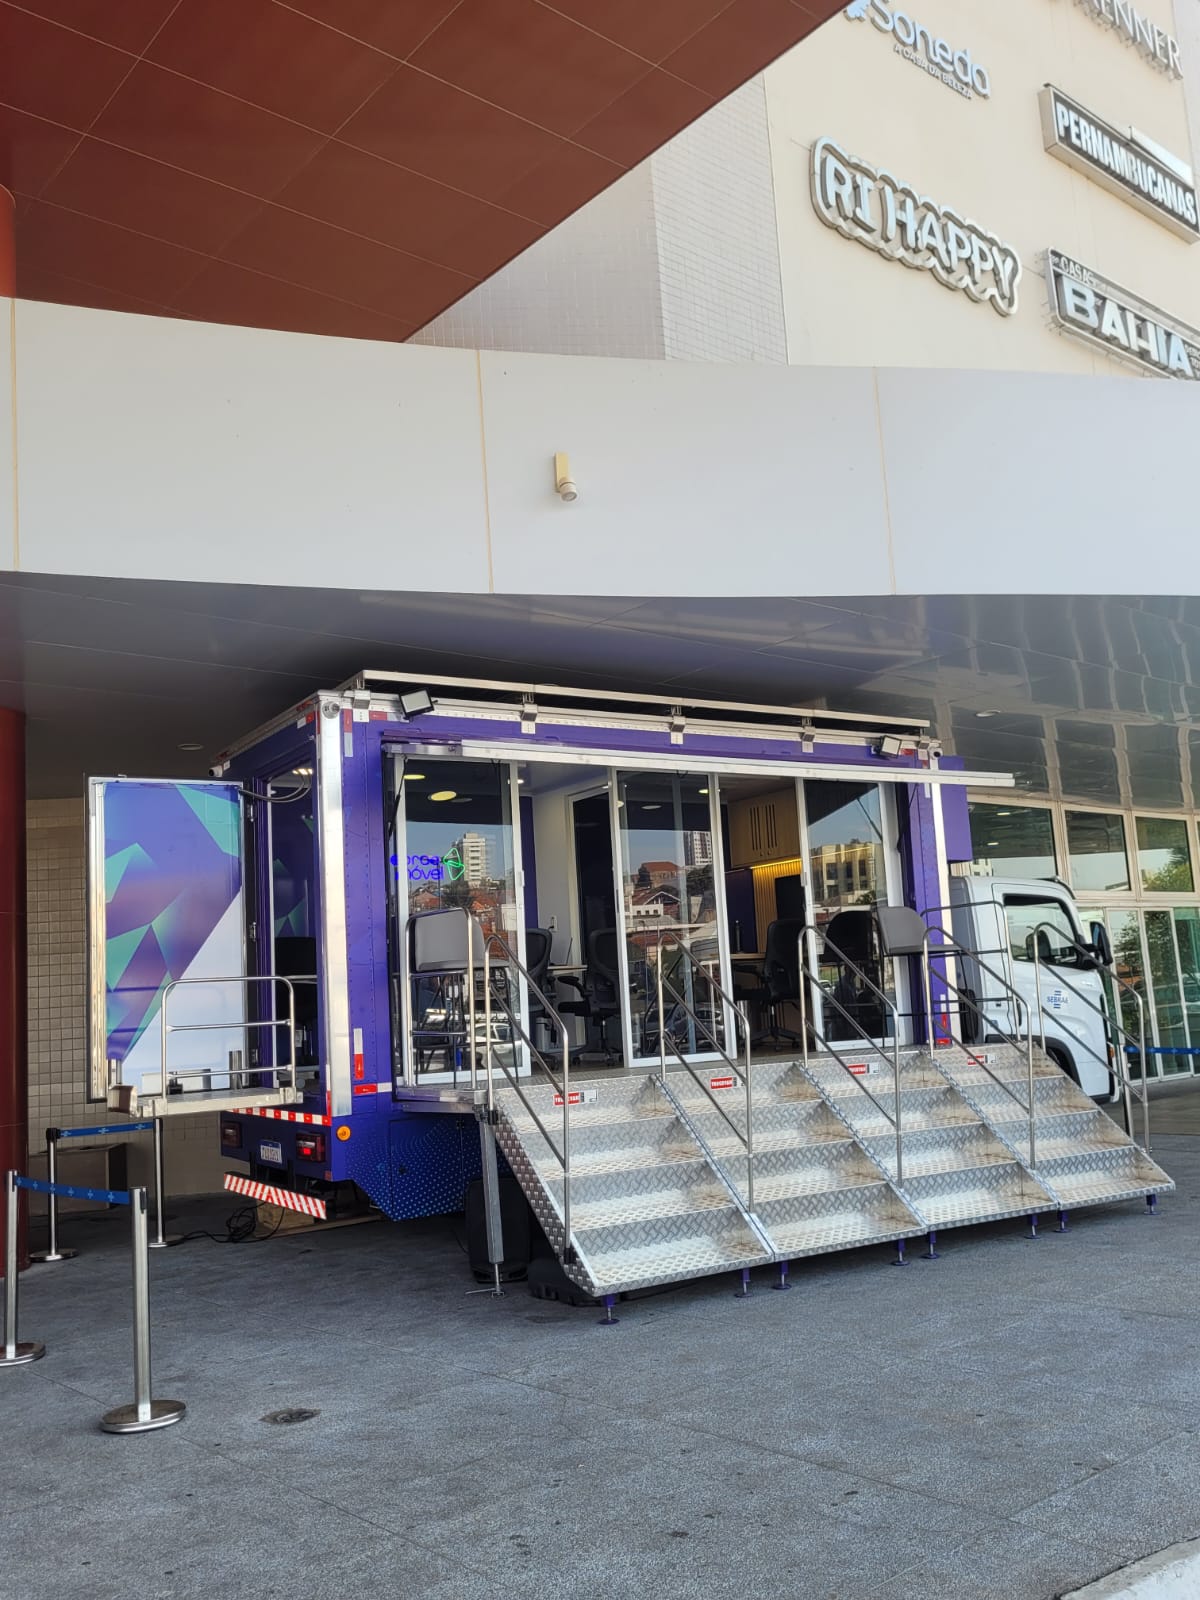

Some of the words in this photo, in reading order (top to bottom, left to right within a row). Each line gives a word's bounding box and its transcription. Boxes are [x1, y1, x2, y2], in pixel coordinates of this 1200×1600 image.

[1092, 0, 1183, 79] ENNER
[1055, 100, 1198, 226] PERNAMBUCANAS
[822, 153, 877, 234] RI
[881, 184, 1014, 300] HAPPY
[1062, 275, 1195, 378] BAHIA
